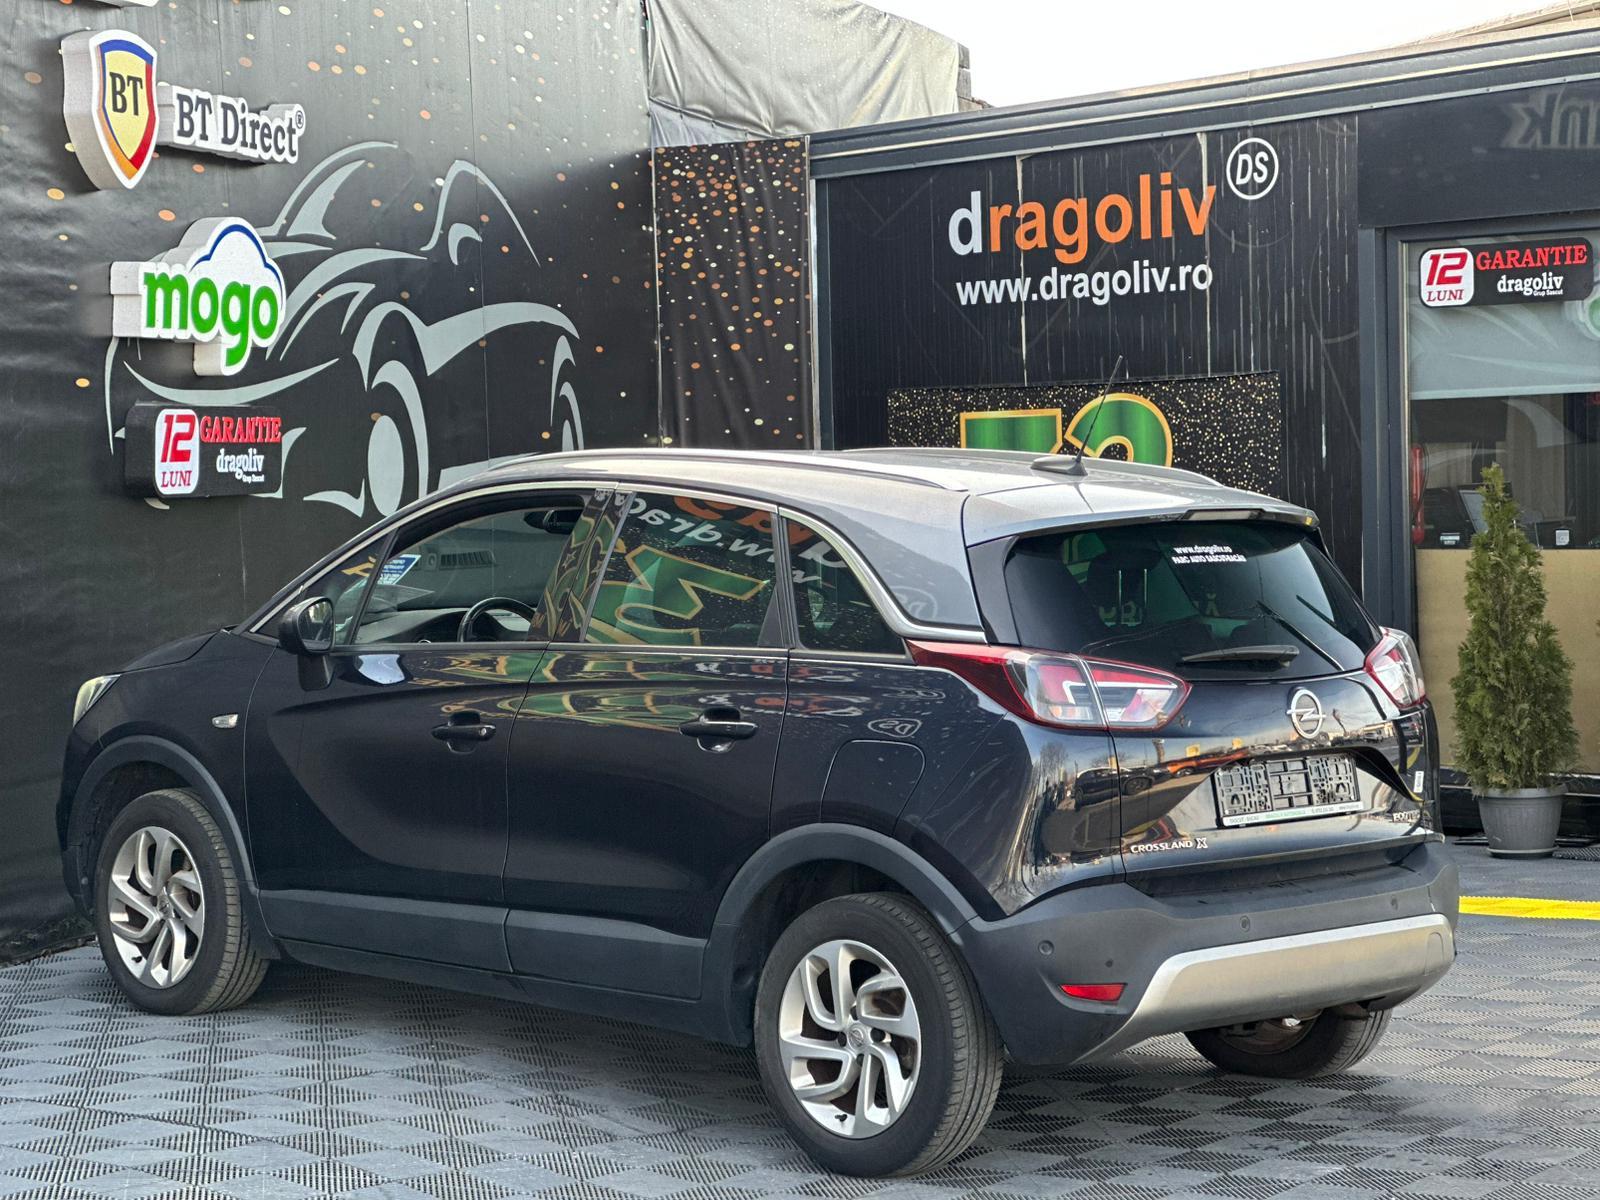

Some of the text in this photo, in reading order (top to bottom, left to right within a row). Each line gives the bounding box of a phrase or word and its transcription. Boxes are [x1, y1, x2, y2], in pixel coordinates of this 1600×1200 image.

[109, 71, 144, 117] BT
[176, 93, 213, 142] BT
[1234, 150, 1270, 186] DS
[948, 172, 1217, 265] dragoliv
[1425, 252, 1468, 287] 12
[1475, 245, 1588, 271] GARANTIE
[956, 260, 1213, 306] www.dragoliv.ro
[1426, 289, 1465, 302] LUNI
[1496, 272, 1564, 297] dragoliv
[143, 271, 279, 368] mogo
[160, 414, 197, 464] 12
[200, 416, 282, 444] GARANTIE
[160, 470, 192, 488] LUNI
[216, 448, 265, 480] dragoliv
[1130, 837, 1209, 853] CROSSLAND X
